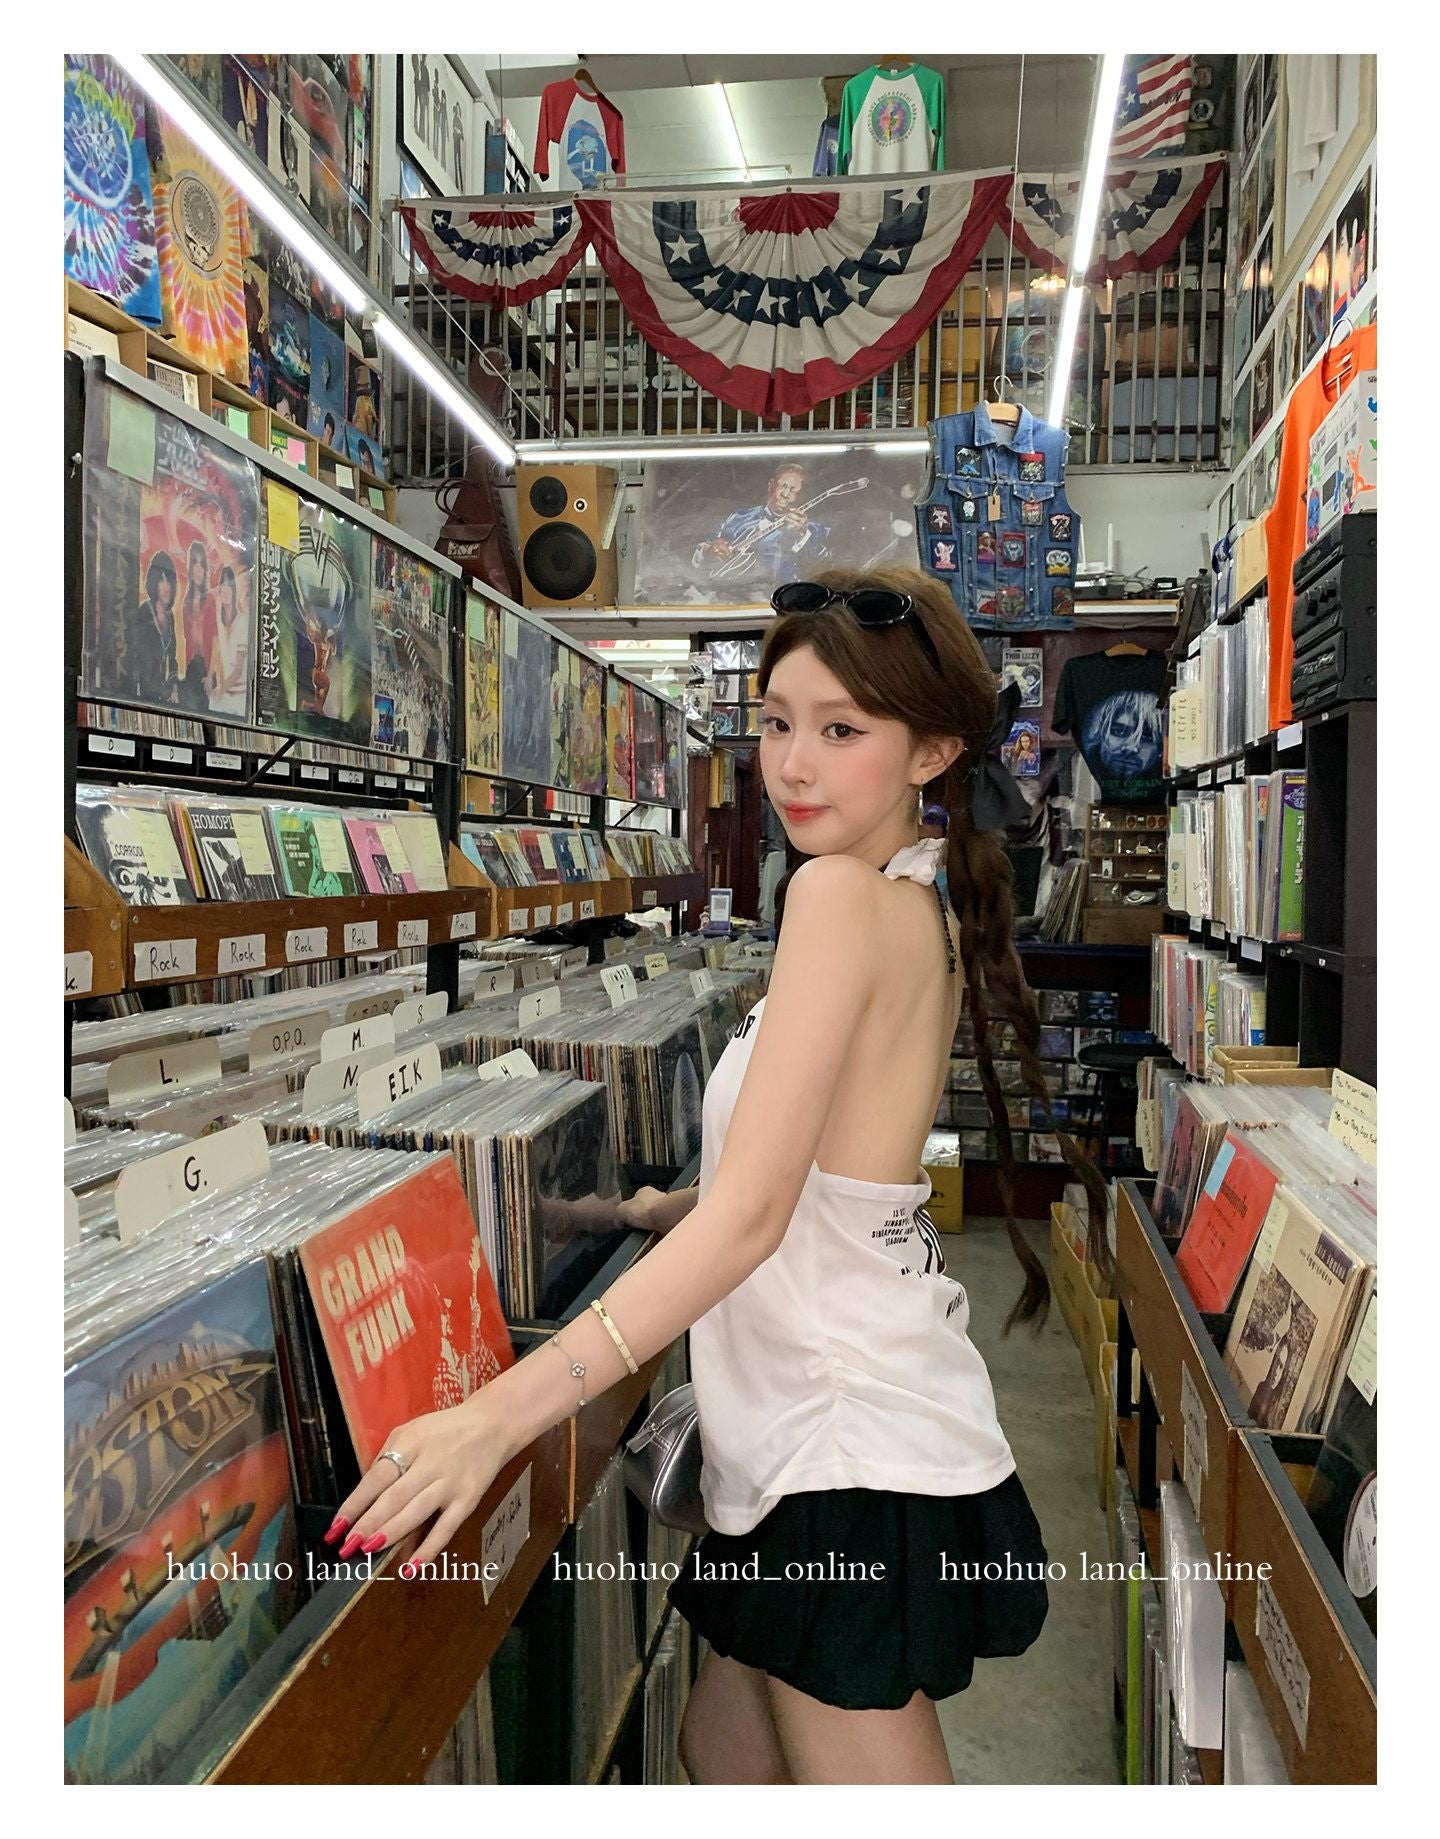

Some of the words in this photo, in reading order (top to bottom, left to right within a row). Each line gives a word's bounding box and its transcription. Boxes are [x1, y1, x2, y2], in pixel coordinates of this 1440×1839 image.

[260, 568, 270, 606] VAN
[260, 614, 270, 679] HALEN
[108, 738, 115, 751] D
[169, 748, 175, 760] D
[150, 943, 180, 976] Rock
[231, 941, 255, 965] Rock
[294, 935, 313, 955] Rock
[183, 1155, 208, 1192] G.
[884, 1236, 909, 1248] STADIUM
[318, 1223, 407, 1321] GRAND
[341, 1288, 418, 1380] FUNK
